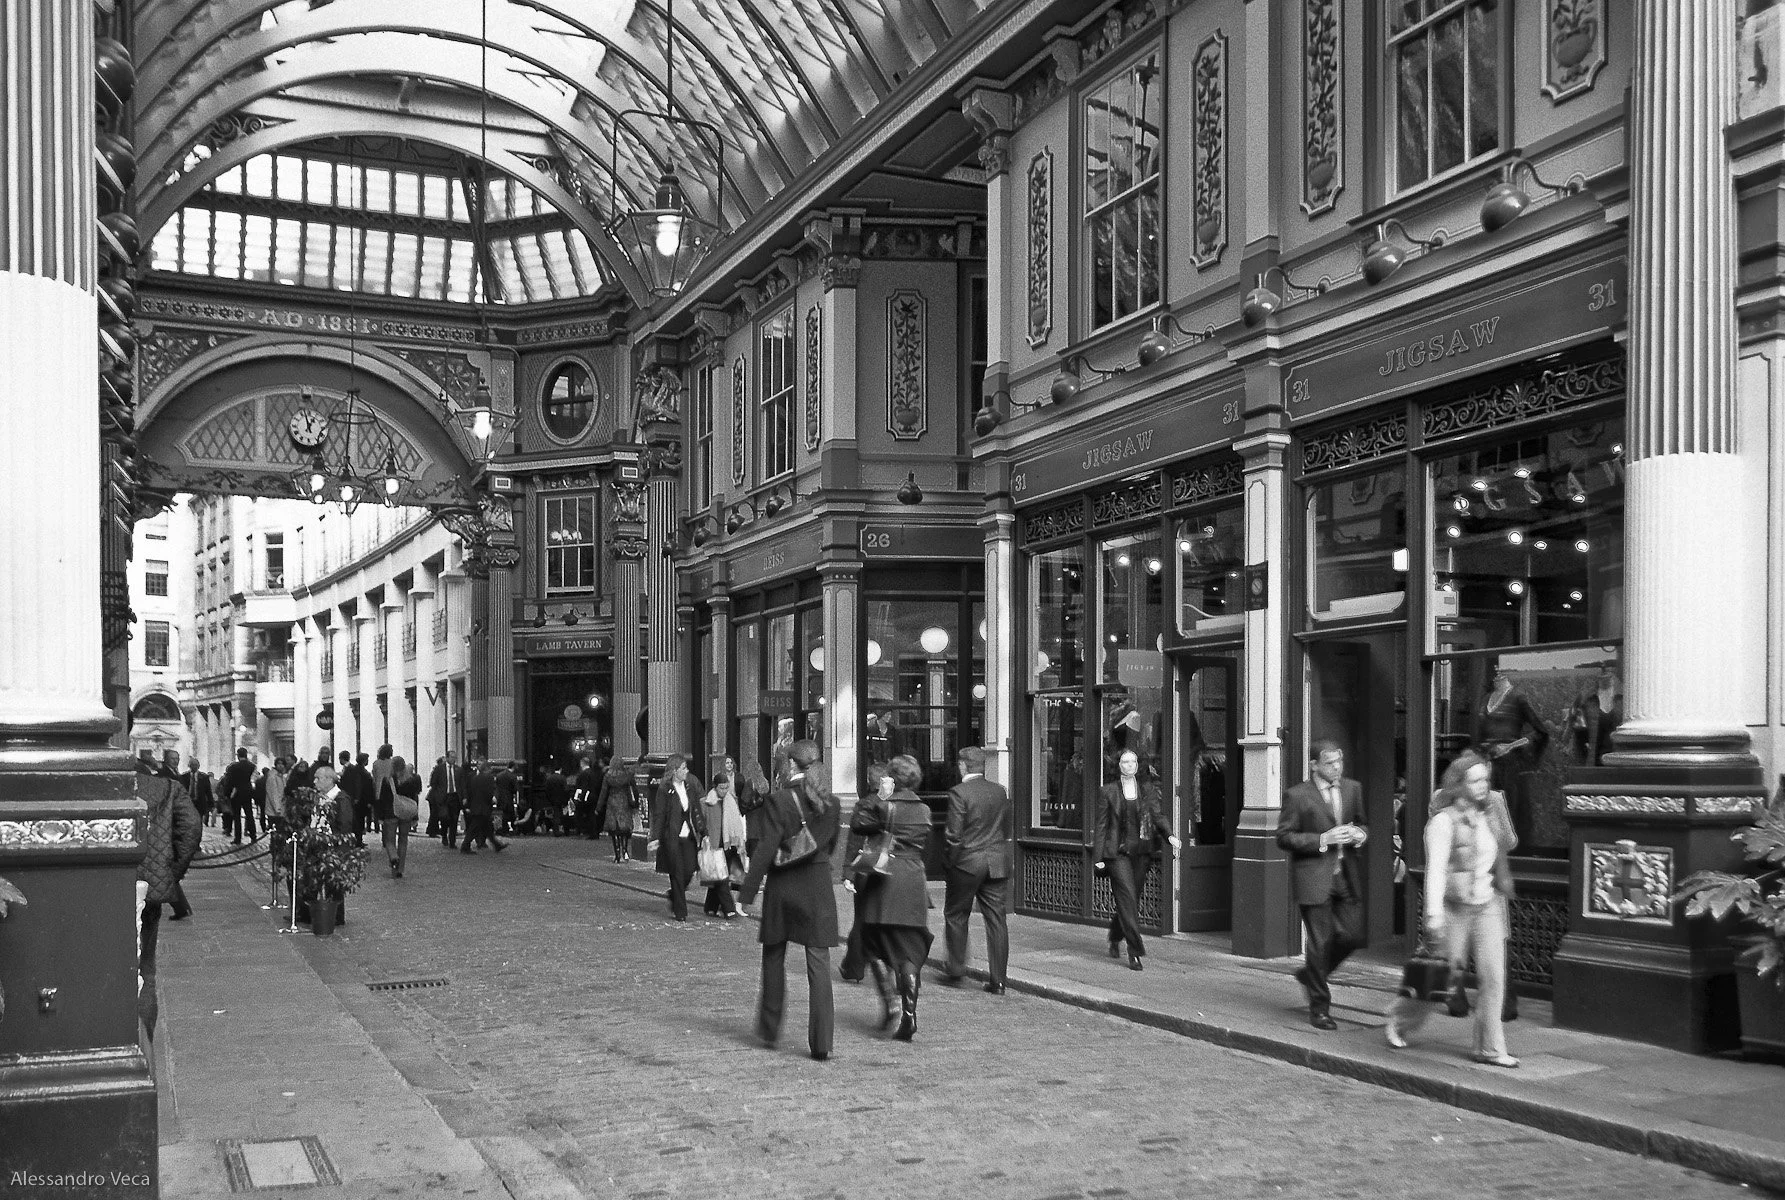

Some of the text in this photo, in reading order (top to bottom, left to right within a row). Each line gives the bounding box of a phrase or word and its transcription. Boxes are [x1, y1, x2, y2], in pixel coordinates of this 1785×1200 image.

[1588, 279, 1616, 311] 31
[1379, 316, 1499, 376] JIGSAW
[1293, 378, 1310, 402] 31
[1222, 400, 1240, 425] 31
[1082, 430, 1154, 470] JIGSAW
[1015, 473, 1027, 493] 31
[867, 532, 891, 548] 26
[763, 552, 785, 571] REISS
[536, 639, 602, 651] LAMB TAVERN
[764, 696, 792, 707] REISS
